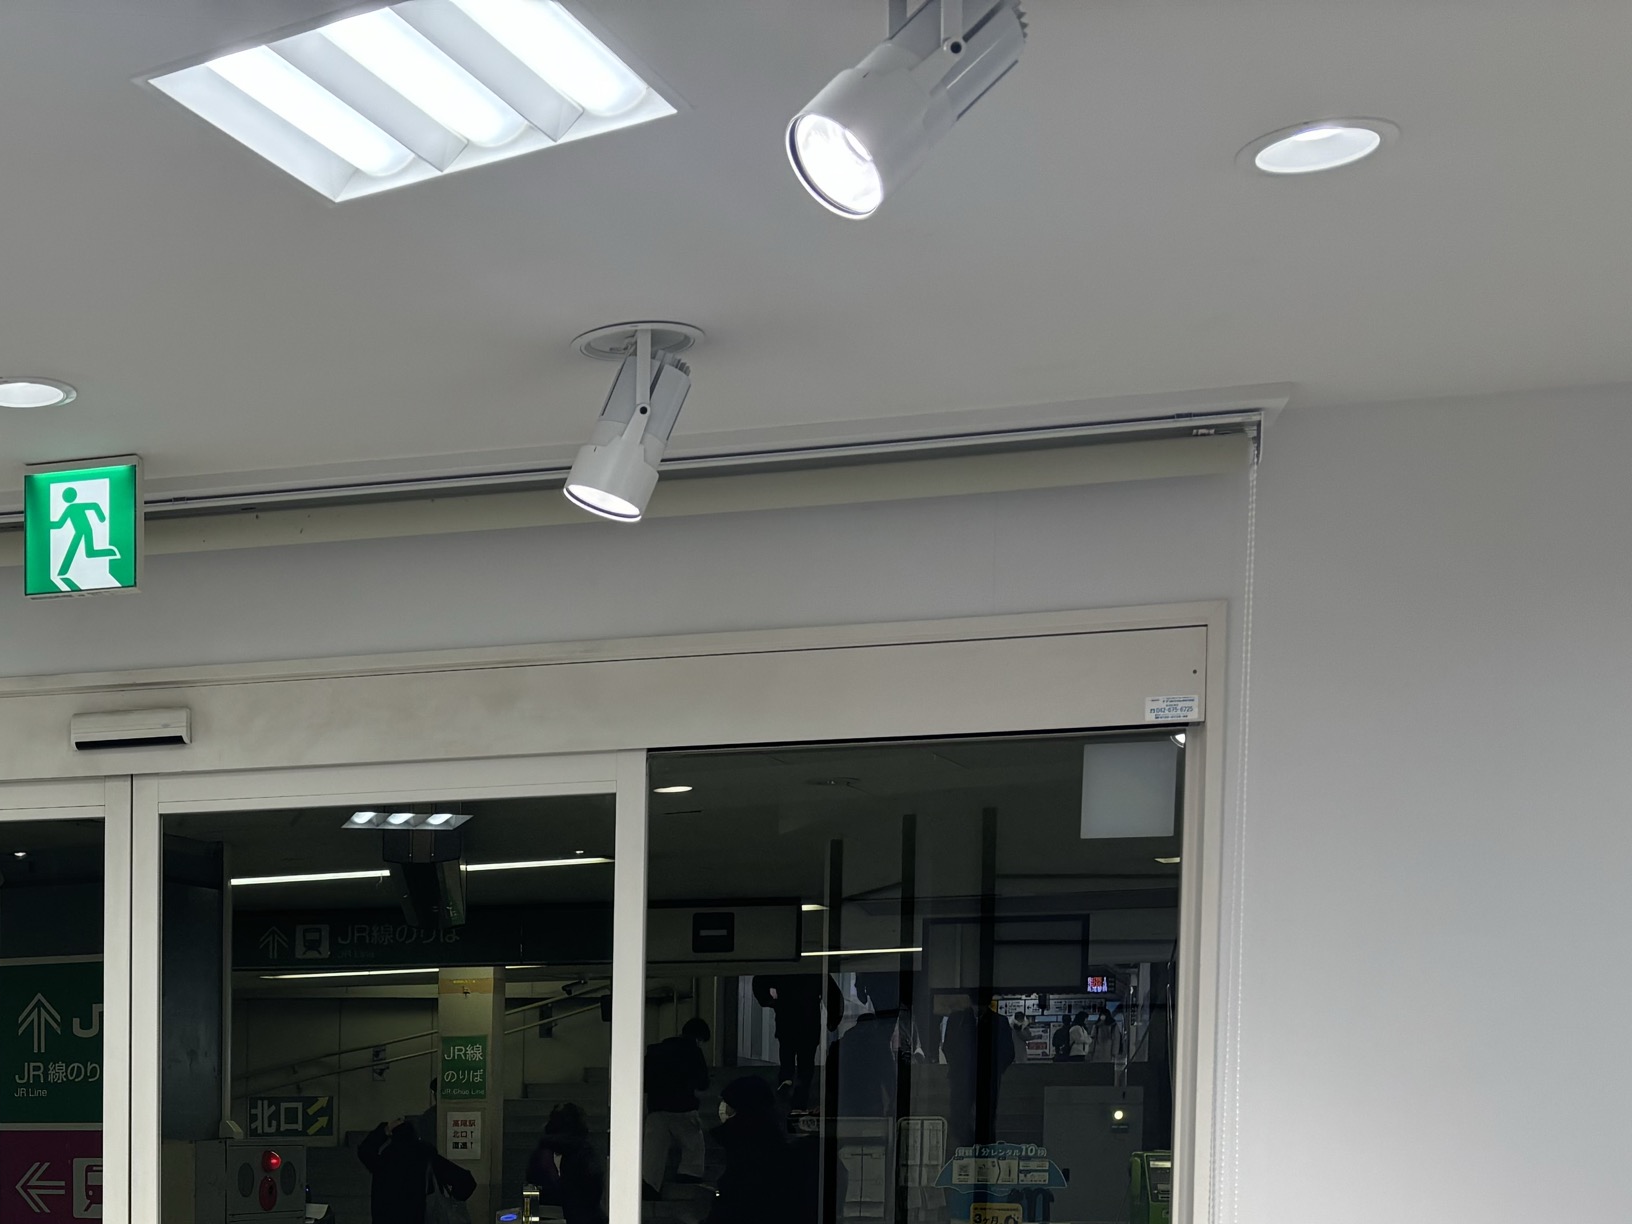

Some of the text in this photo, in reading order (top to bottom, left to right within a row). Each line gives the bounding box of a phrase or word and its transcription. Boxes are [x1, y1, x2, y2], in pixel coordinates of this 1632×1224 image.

[72, 1003, 104, 1038] J
[444, 1044, 484, 1061] JR線
[14, 1061, 101, 1084] JR線のり
[443, 1069, 484, 1084] のりば
[14, 1088, 48, 1097] JR Line
[250, 1099, 304, 1134] 北口
[452, 1130, 468, 1139] 北口
